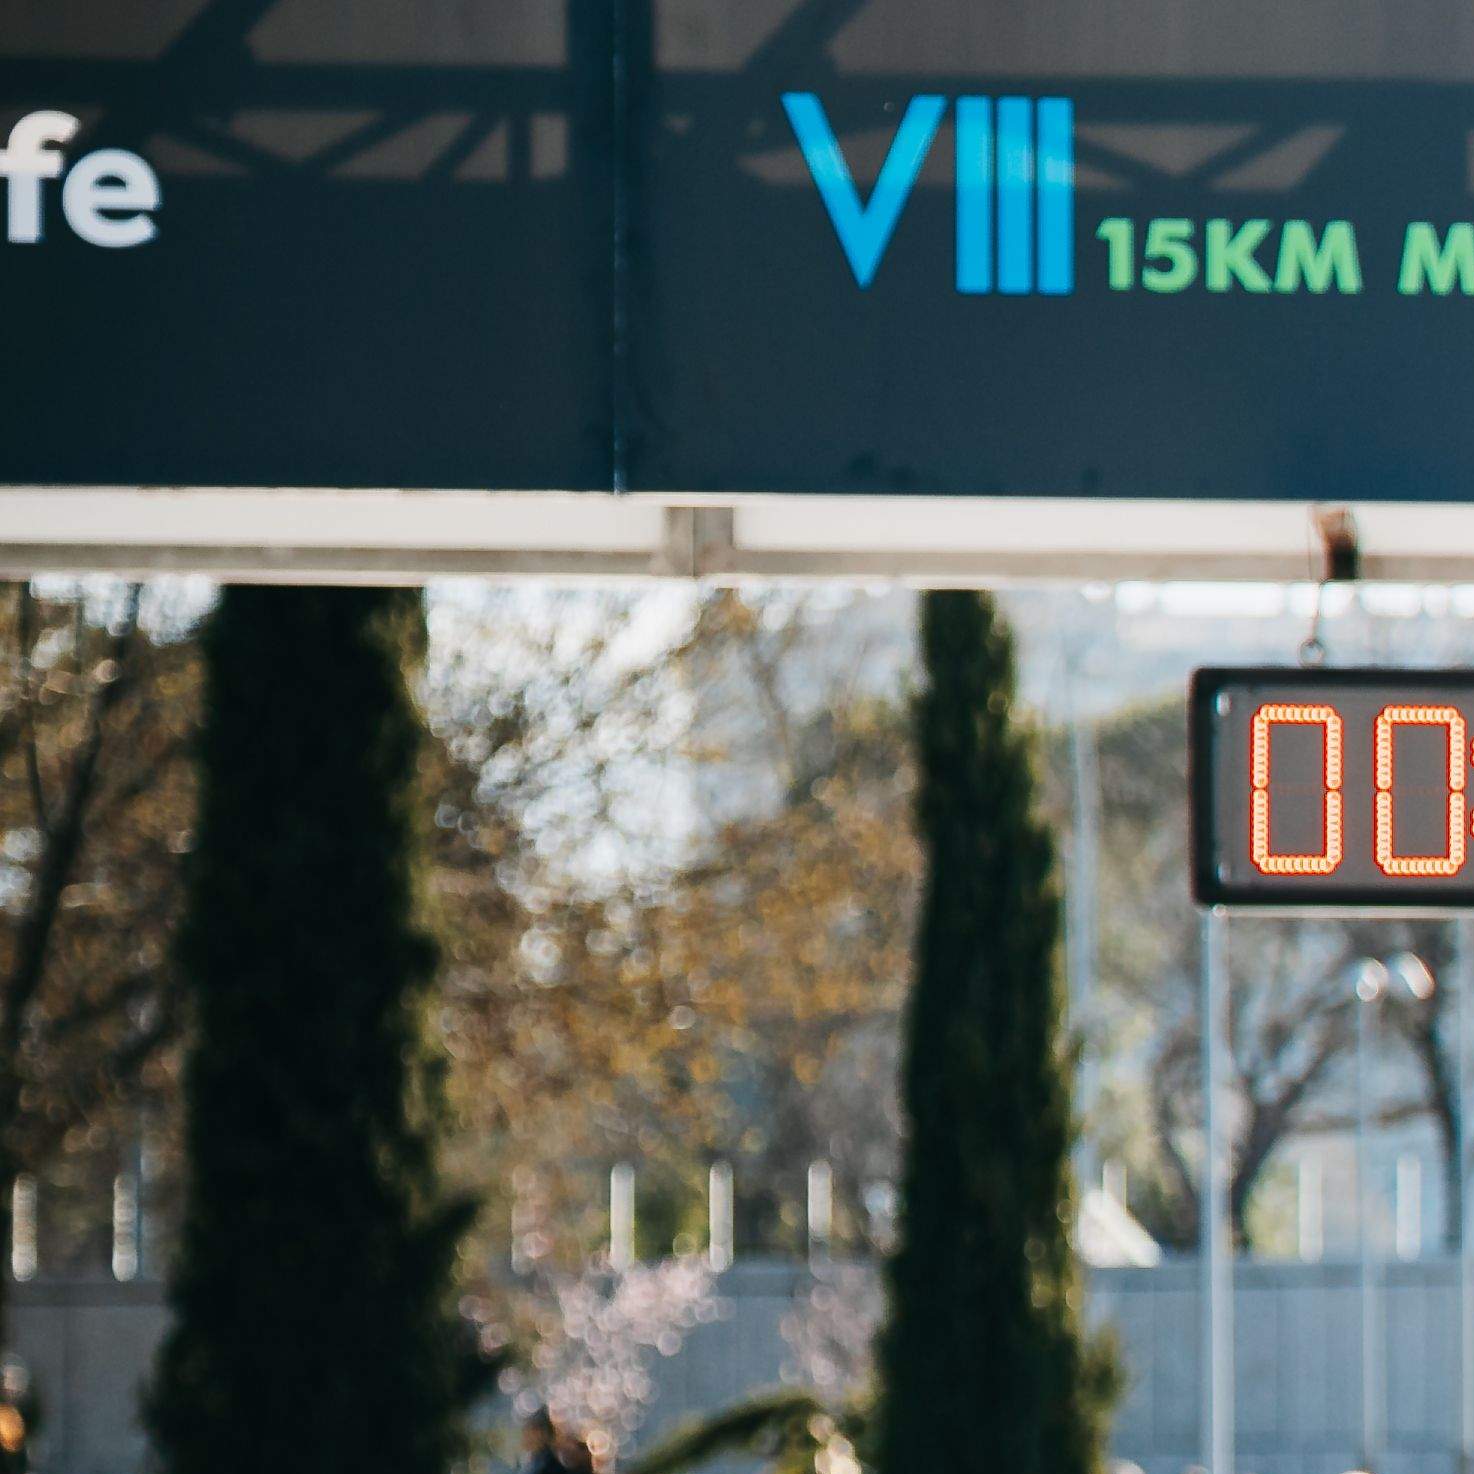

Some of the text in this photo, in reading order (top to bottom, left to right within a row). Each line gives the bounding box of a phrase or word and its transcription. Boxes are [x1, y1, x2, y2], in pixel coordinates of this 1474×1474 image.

[0, 109, 161, 249] fe
[780, 92, 1076, 296] VIII
[1096, 217, 1364, 296] 15KM
